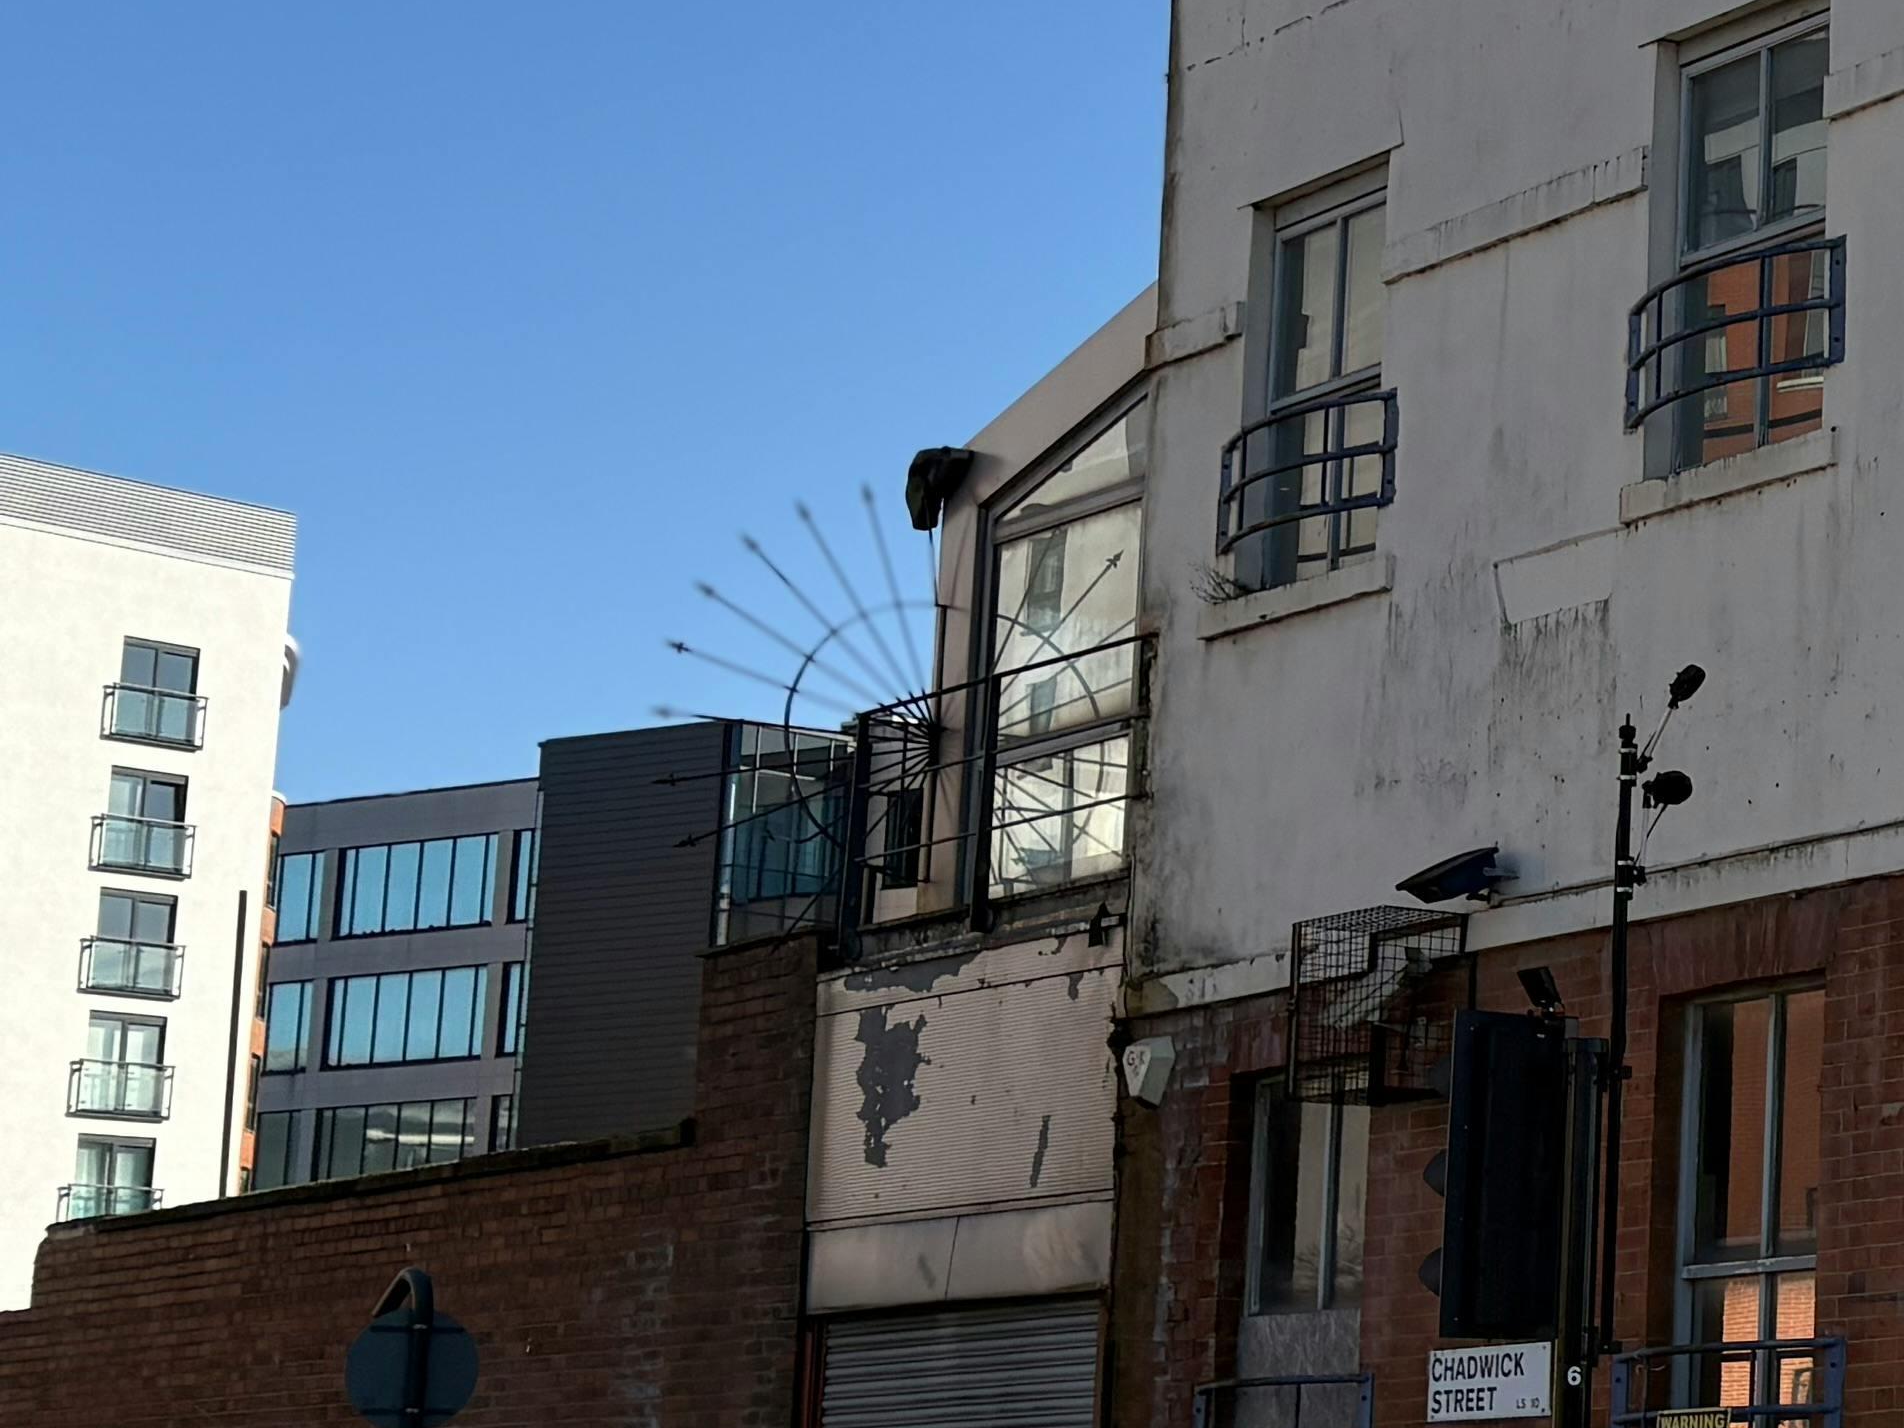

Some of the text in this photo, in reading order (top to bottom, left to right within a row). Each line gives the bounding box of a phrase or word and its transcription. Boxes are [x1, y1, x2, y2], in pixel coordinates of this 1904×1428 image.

[1431, 1352, 1525, 1383] CHADWICK
[1567, 1366, 1582, 1386] 6
[1431, 1386, 1497, 1414] STREET
[1516, 1398, 1526, 1409] LS
